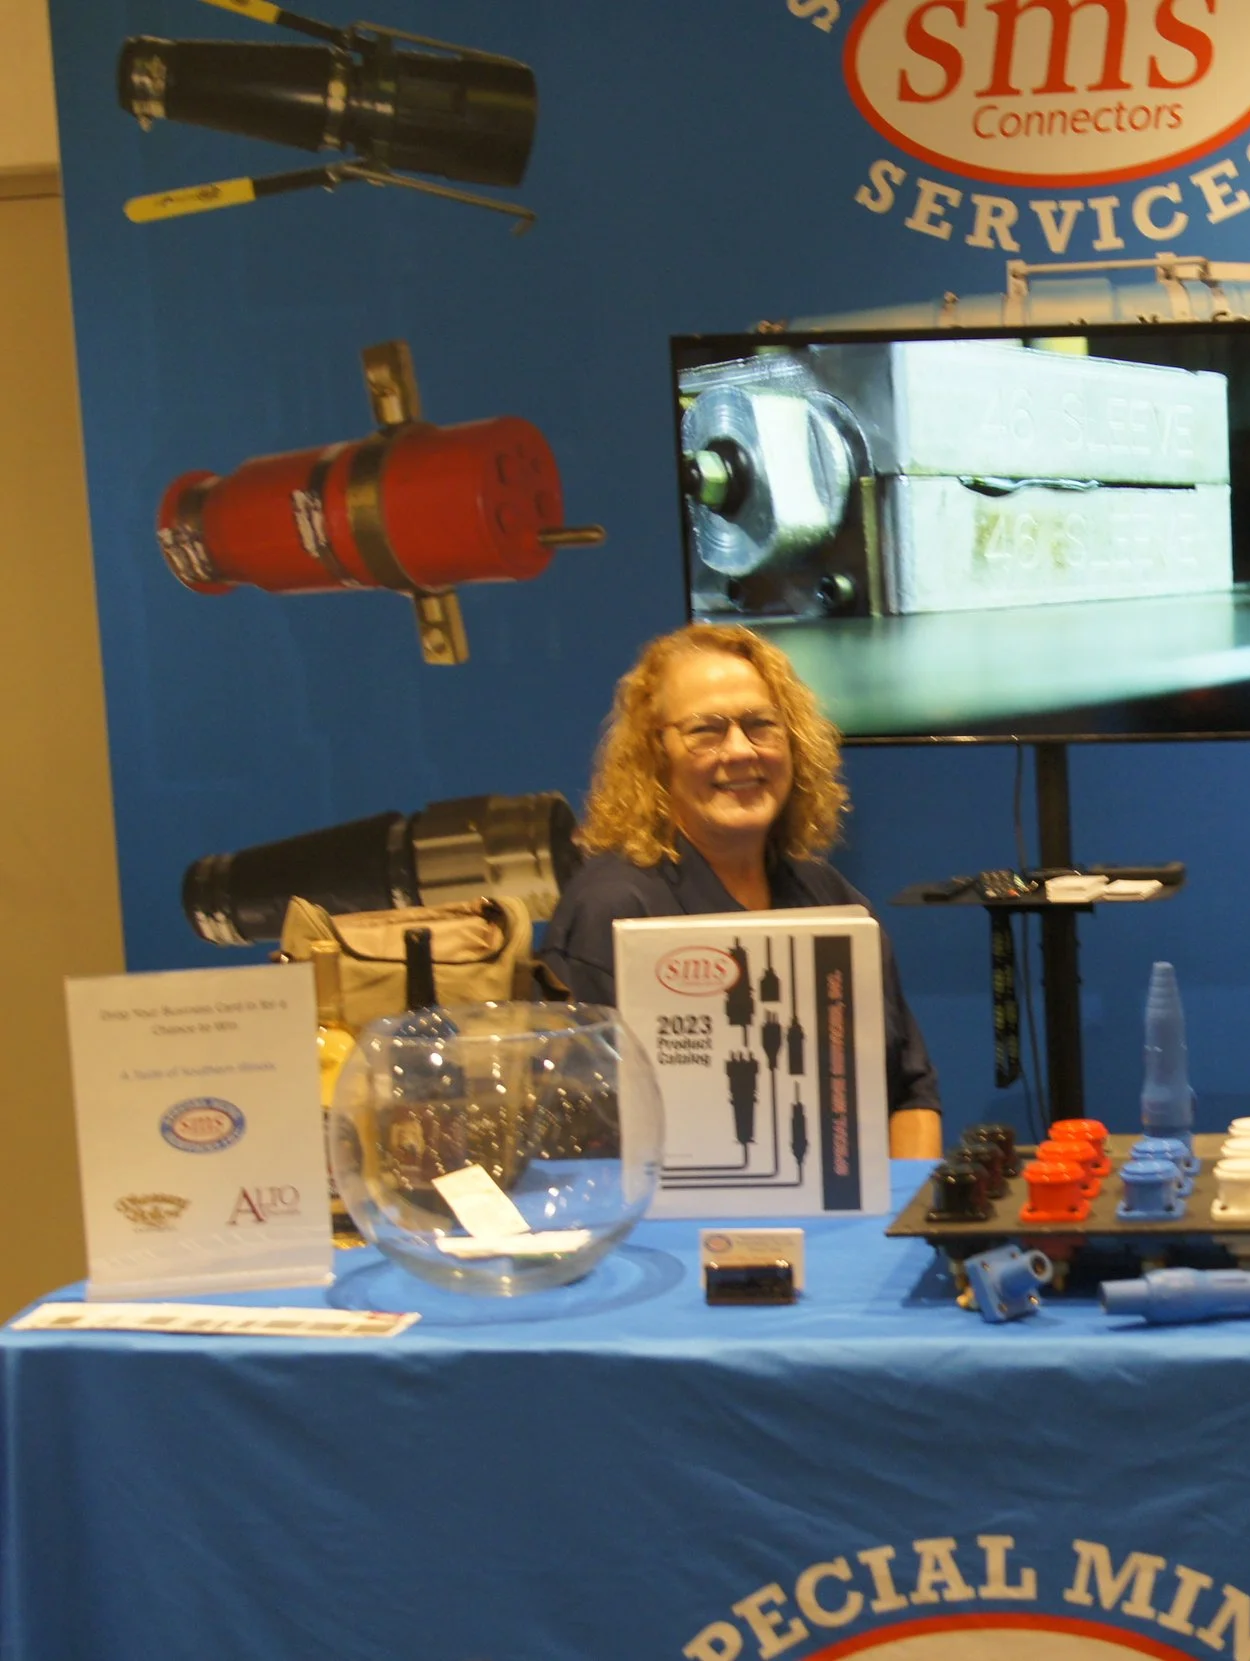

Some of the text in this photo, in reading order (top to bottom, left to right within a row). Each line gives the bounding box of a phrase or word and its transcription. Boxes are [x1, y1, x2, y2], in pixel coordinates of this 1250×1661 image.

[897, 0, 1215, 104] sms
[972, 102, 1184, 140] Connectors
[657, 1015, 712, 1035] 2023
